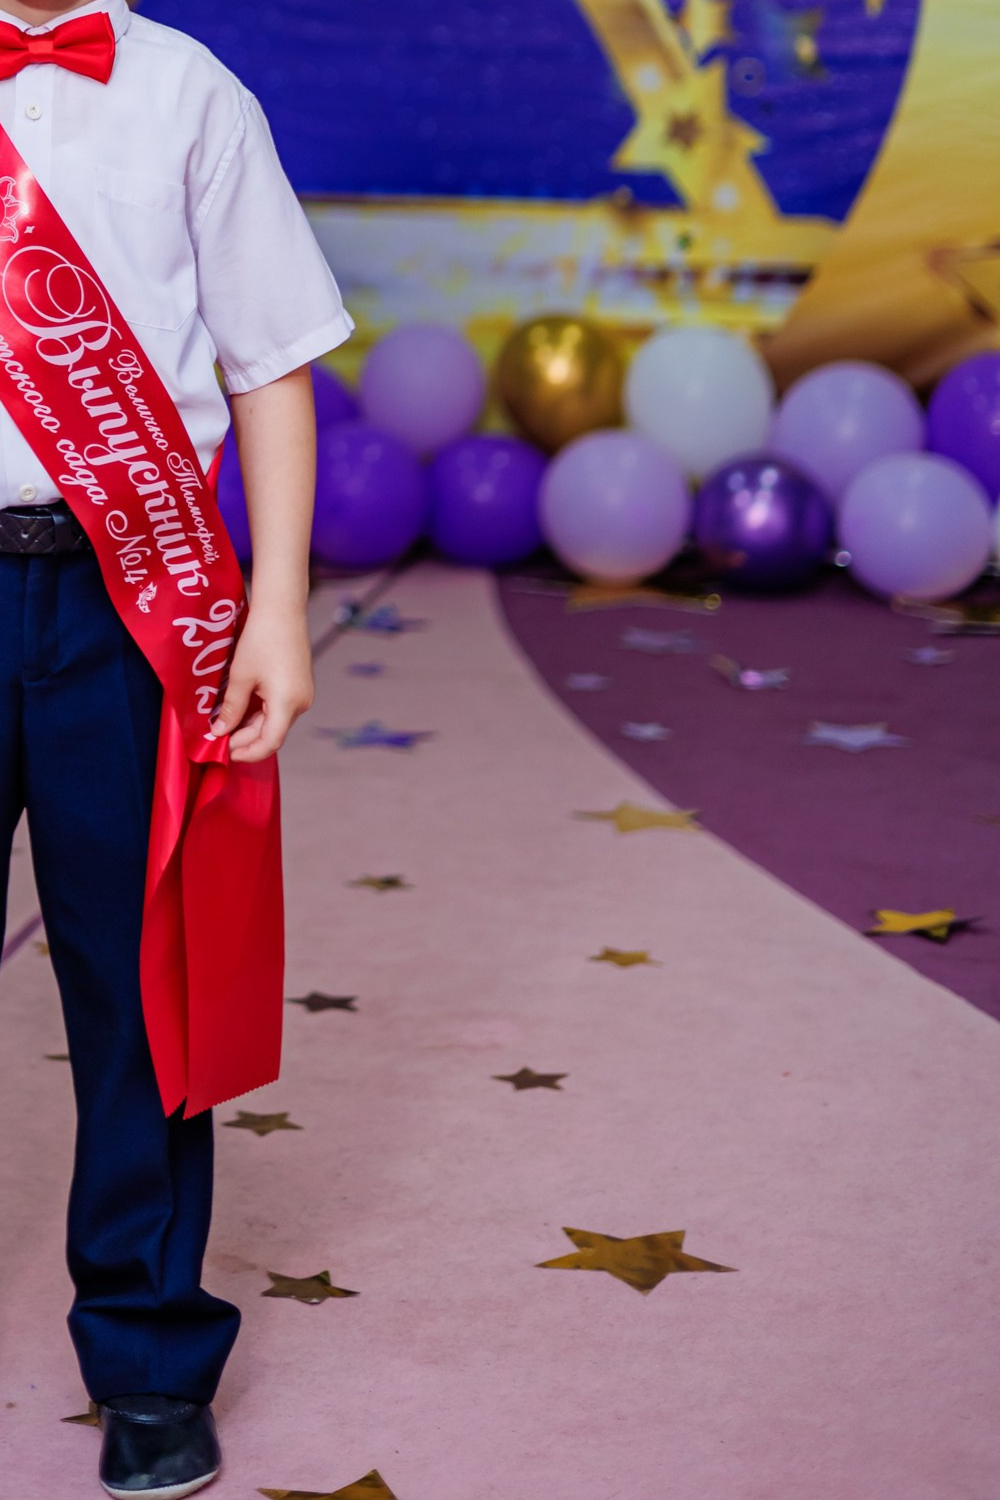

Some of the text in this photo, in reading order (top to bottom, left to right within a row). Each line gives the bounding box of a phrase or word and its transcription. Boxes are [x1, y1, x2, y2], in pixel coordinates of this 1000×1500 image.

[1, 245, 237, 742] Выпускник 20
[55, 438, 109, 506] сада
[108, 349, 220, 565] Величко Тимофей
